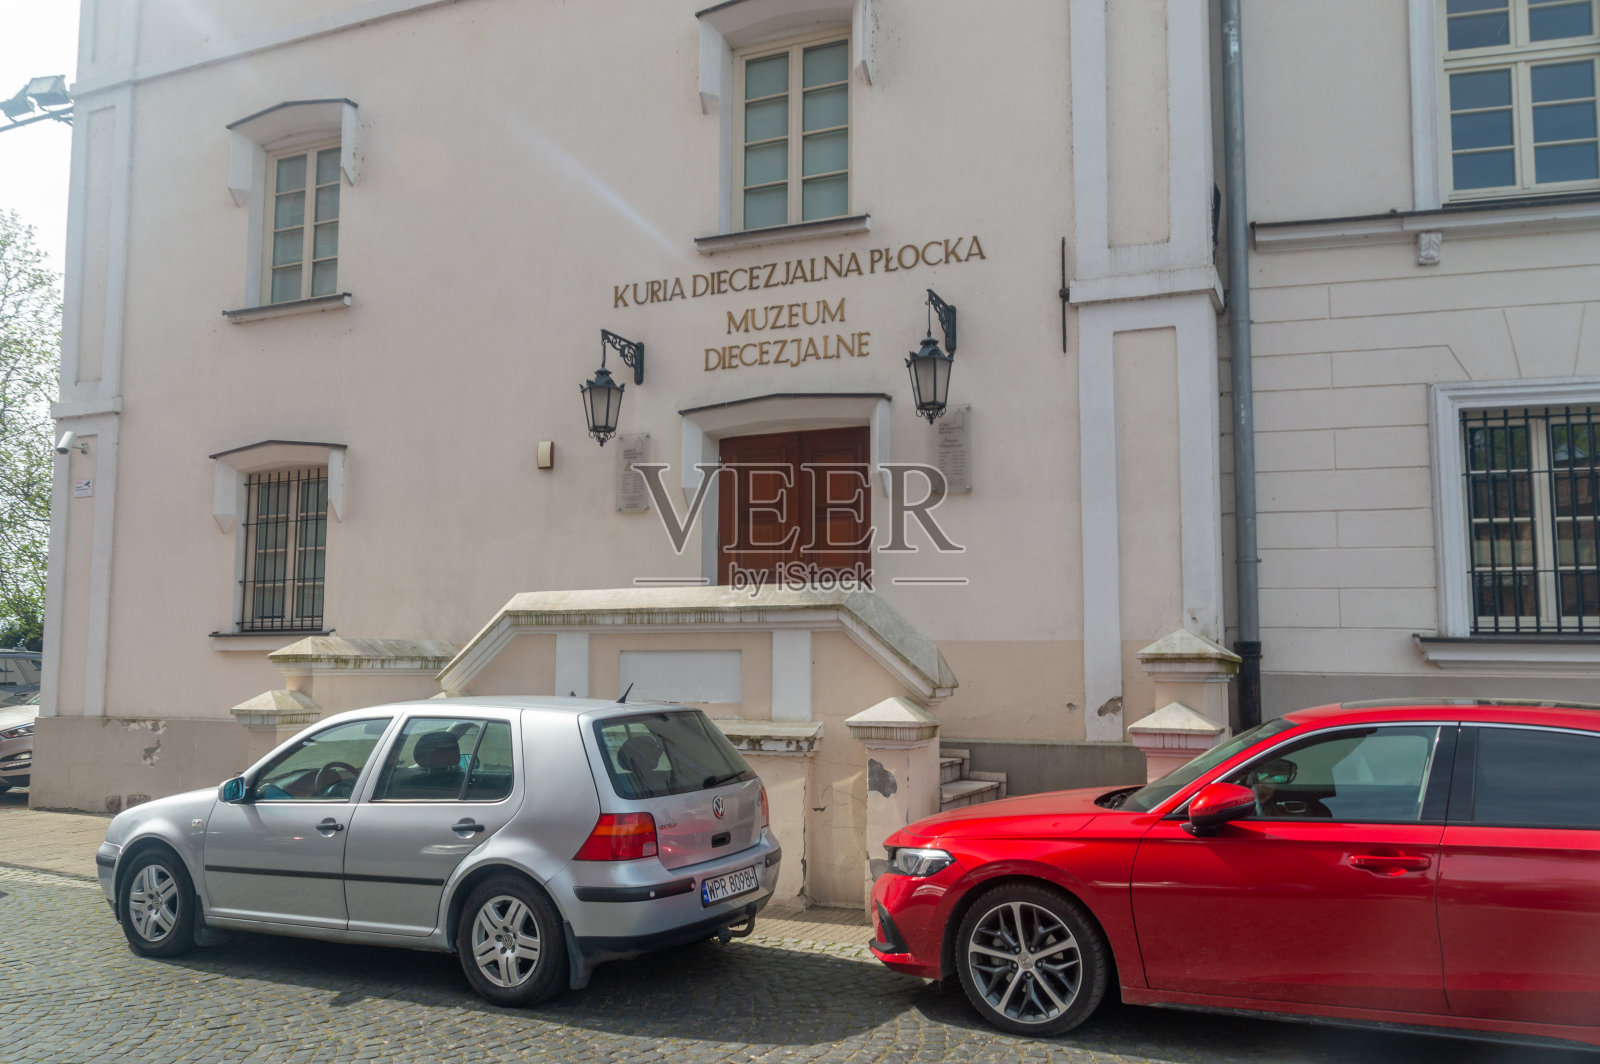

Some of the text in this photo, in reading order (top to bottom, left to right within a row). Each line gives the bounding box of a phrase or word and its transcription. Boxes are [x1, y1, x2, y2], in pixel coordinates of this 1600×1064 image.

[613, 235, 986, 308] KURIA DIECEZJALNA PŁOCKA
[726, 297, 846, 335] MUZEUM
[703, 331, 872, 372] DIECEZJALNE
[706, 878, 729, 899] WPR
